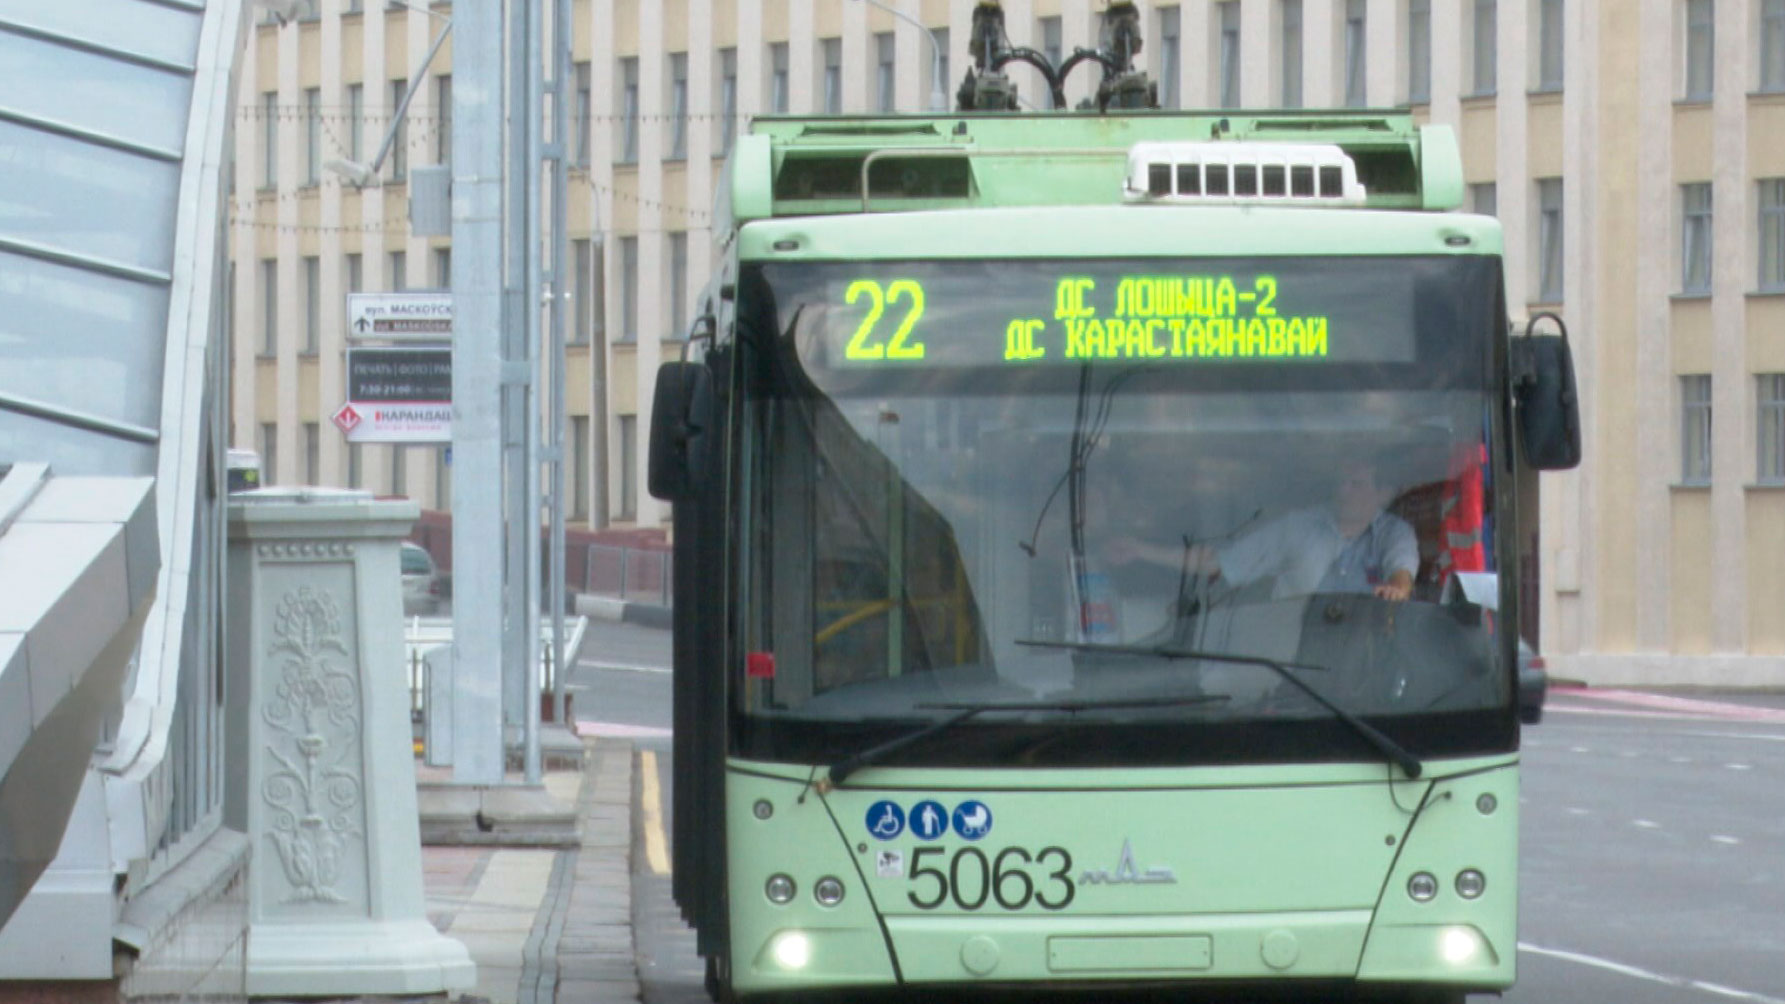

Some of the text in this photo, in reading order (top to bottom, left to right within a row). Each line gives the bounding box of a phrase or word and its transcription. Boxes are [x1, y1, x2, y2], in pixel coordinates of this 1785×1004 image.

[845, 280, 925, 360] 22
[1054, 277, 1278, 319] ДС ЛОШЫЦА-2
[1004, 317, 1329, 360] ДС КАРАСТАЯНАВАЙ
[908, 845, 1076, 911] 5063
